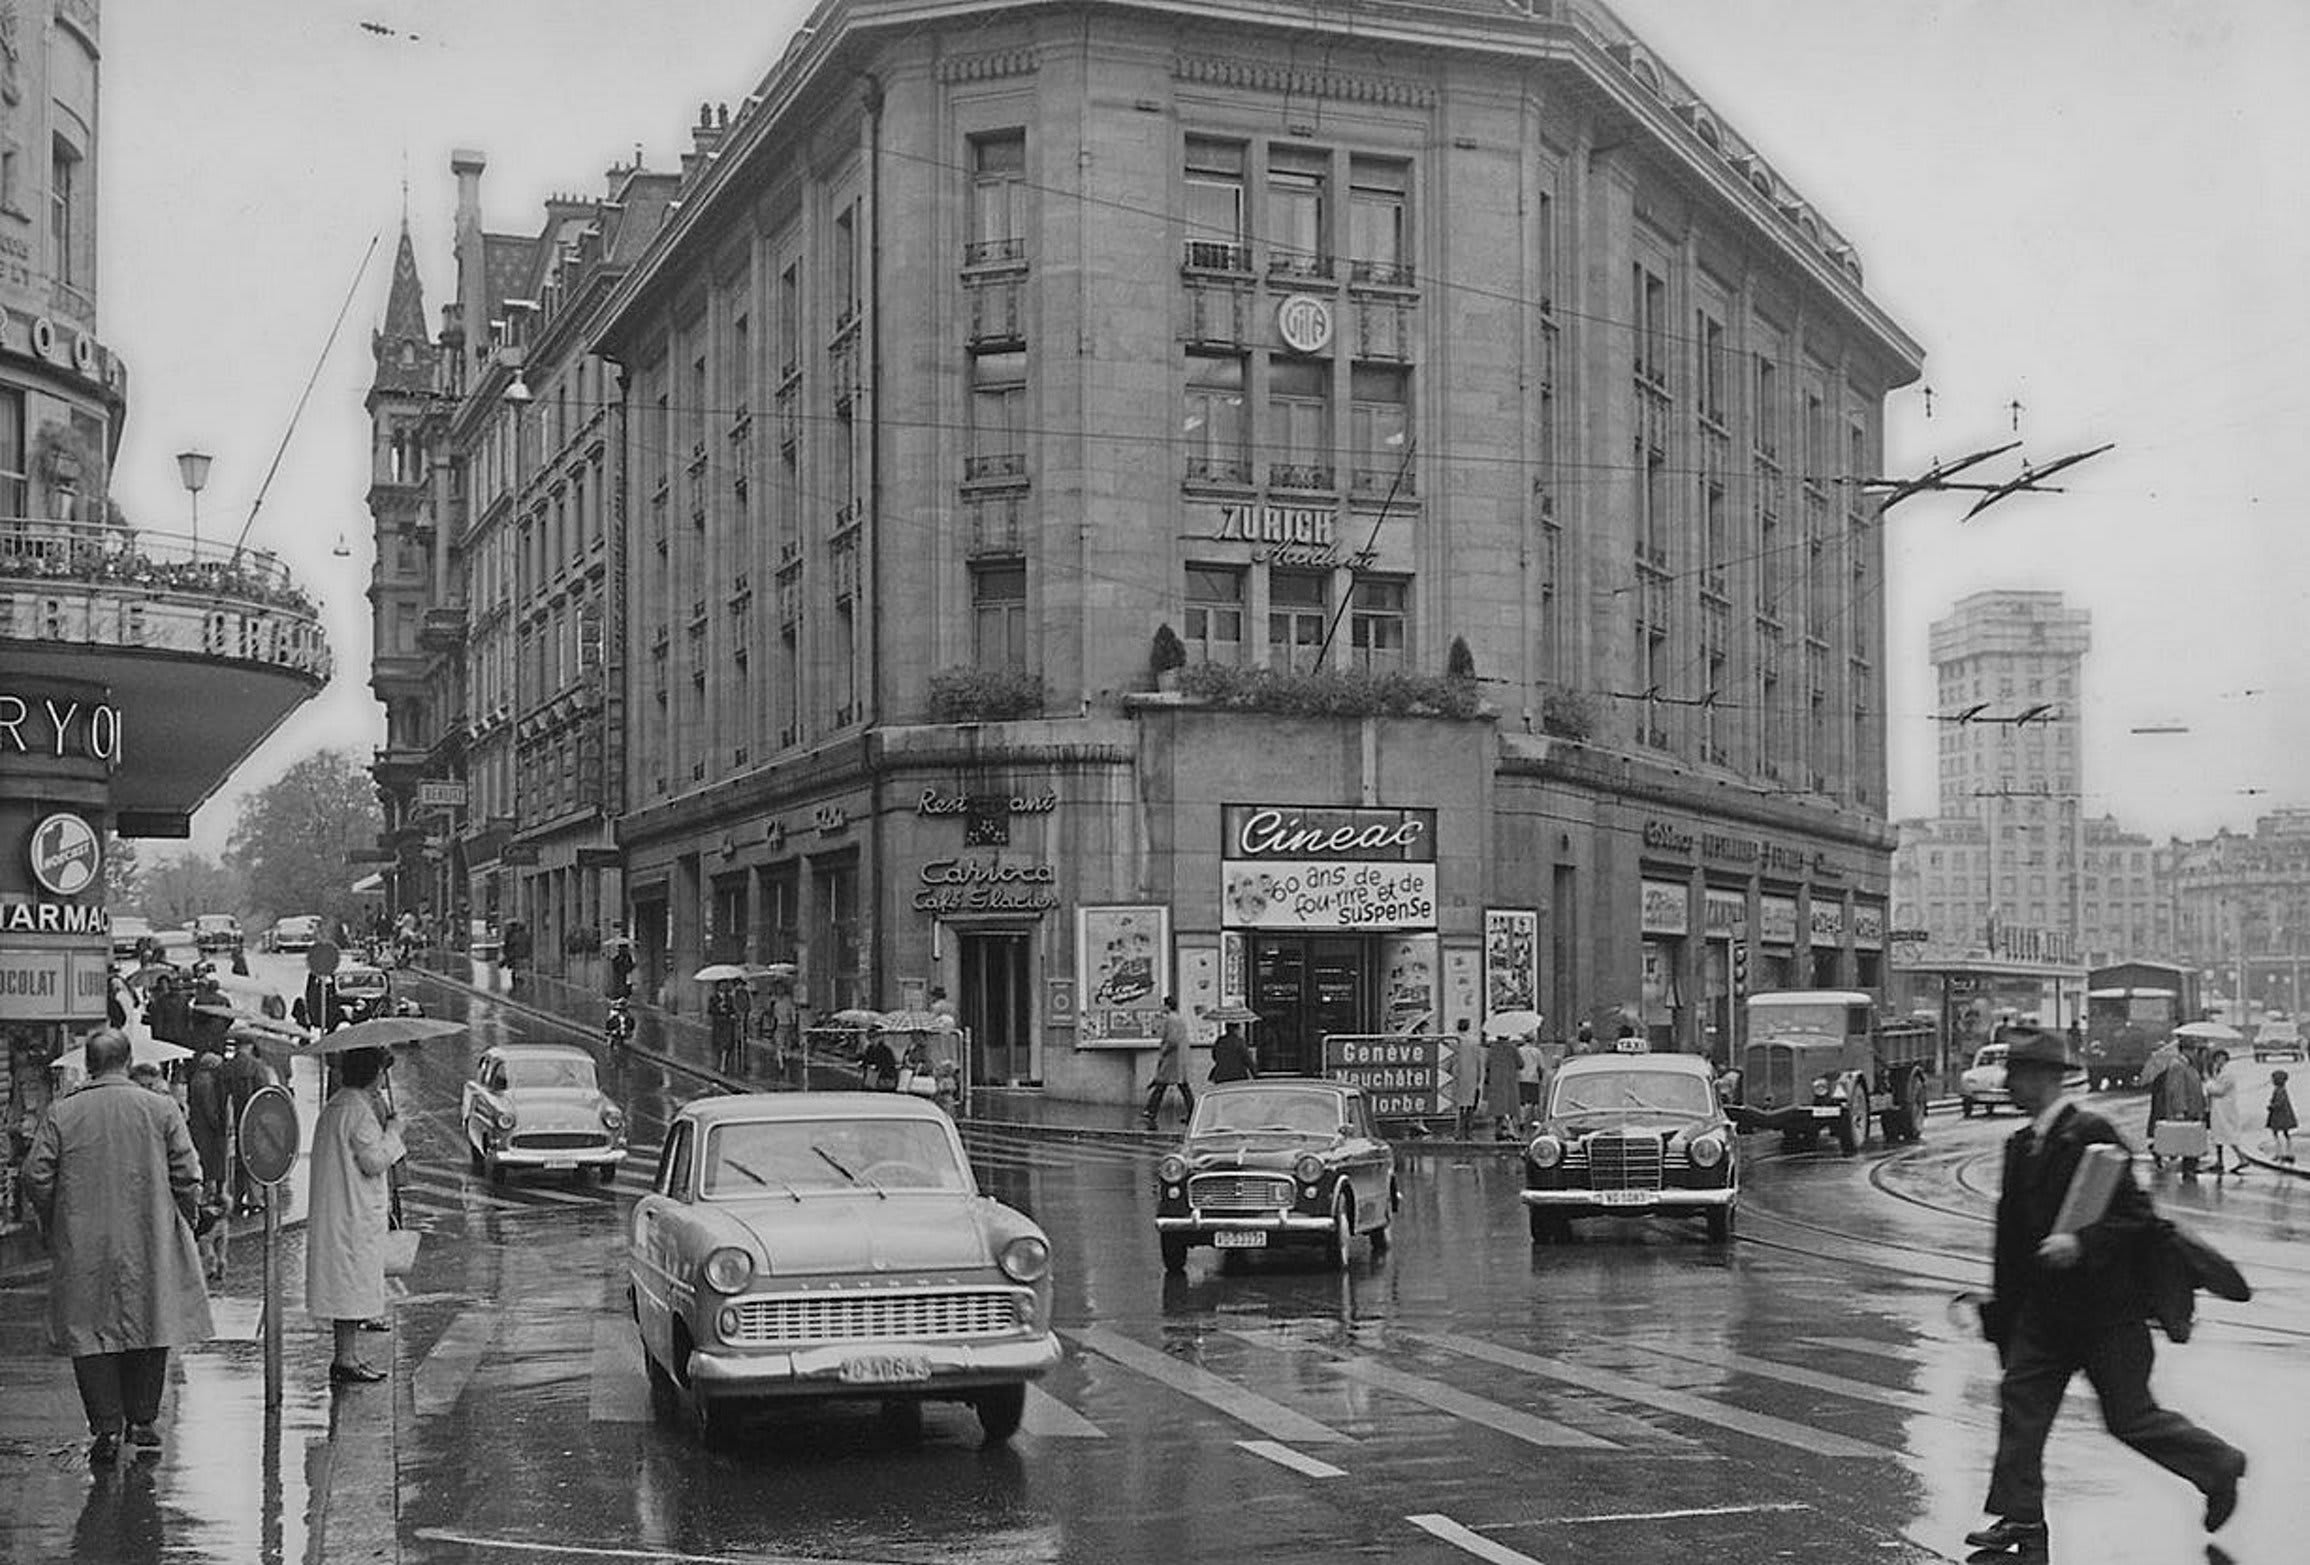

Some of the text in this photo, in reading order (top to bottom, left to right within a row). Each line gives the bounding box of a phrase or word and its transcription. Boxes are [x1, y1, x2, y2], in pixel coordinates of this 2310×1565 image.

[921, 860, 1054, 884] Carioca
[1270, 866, 1381, 902] 60 ans de
[1294, 872, 1423, 920] fou-rire et de
[1338, 897, 1431, 924] suspense
[1343, 1042, 1424, 1063] Genève
[1371, 1095, 1425, 1114] lorbe
